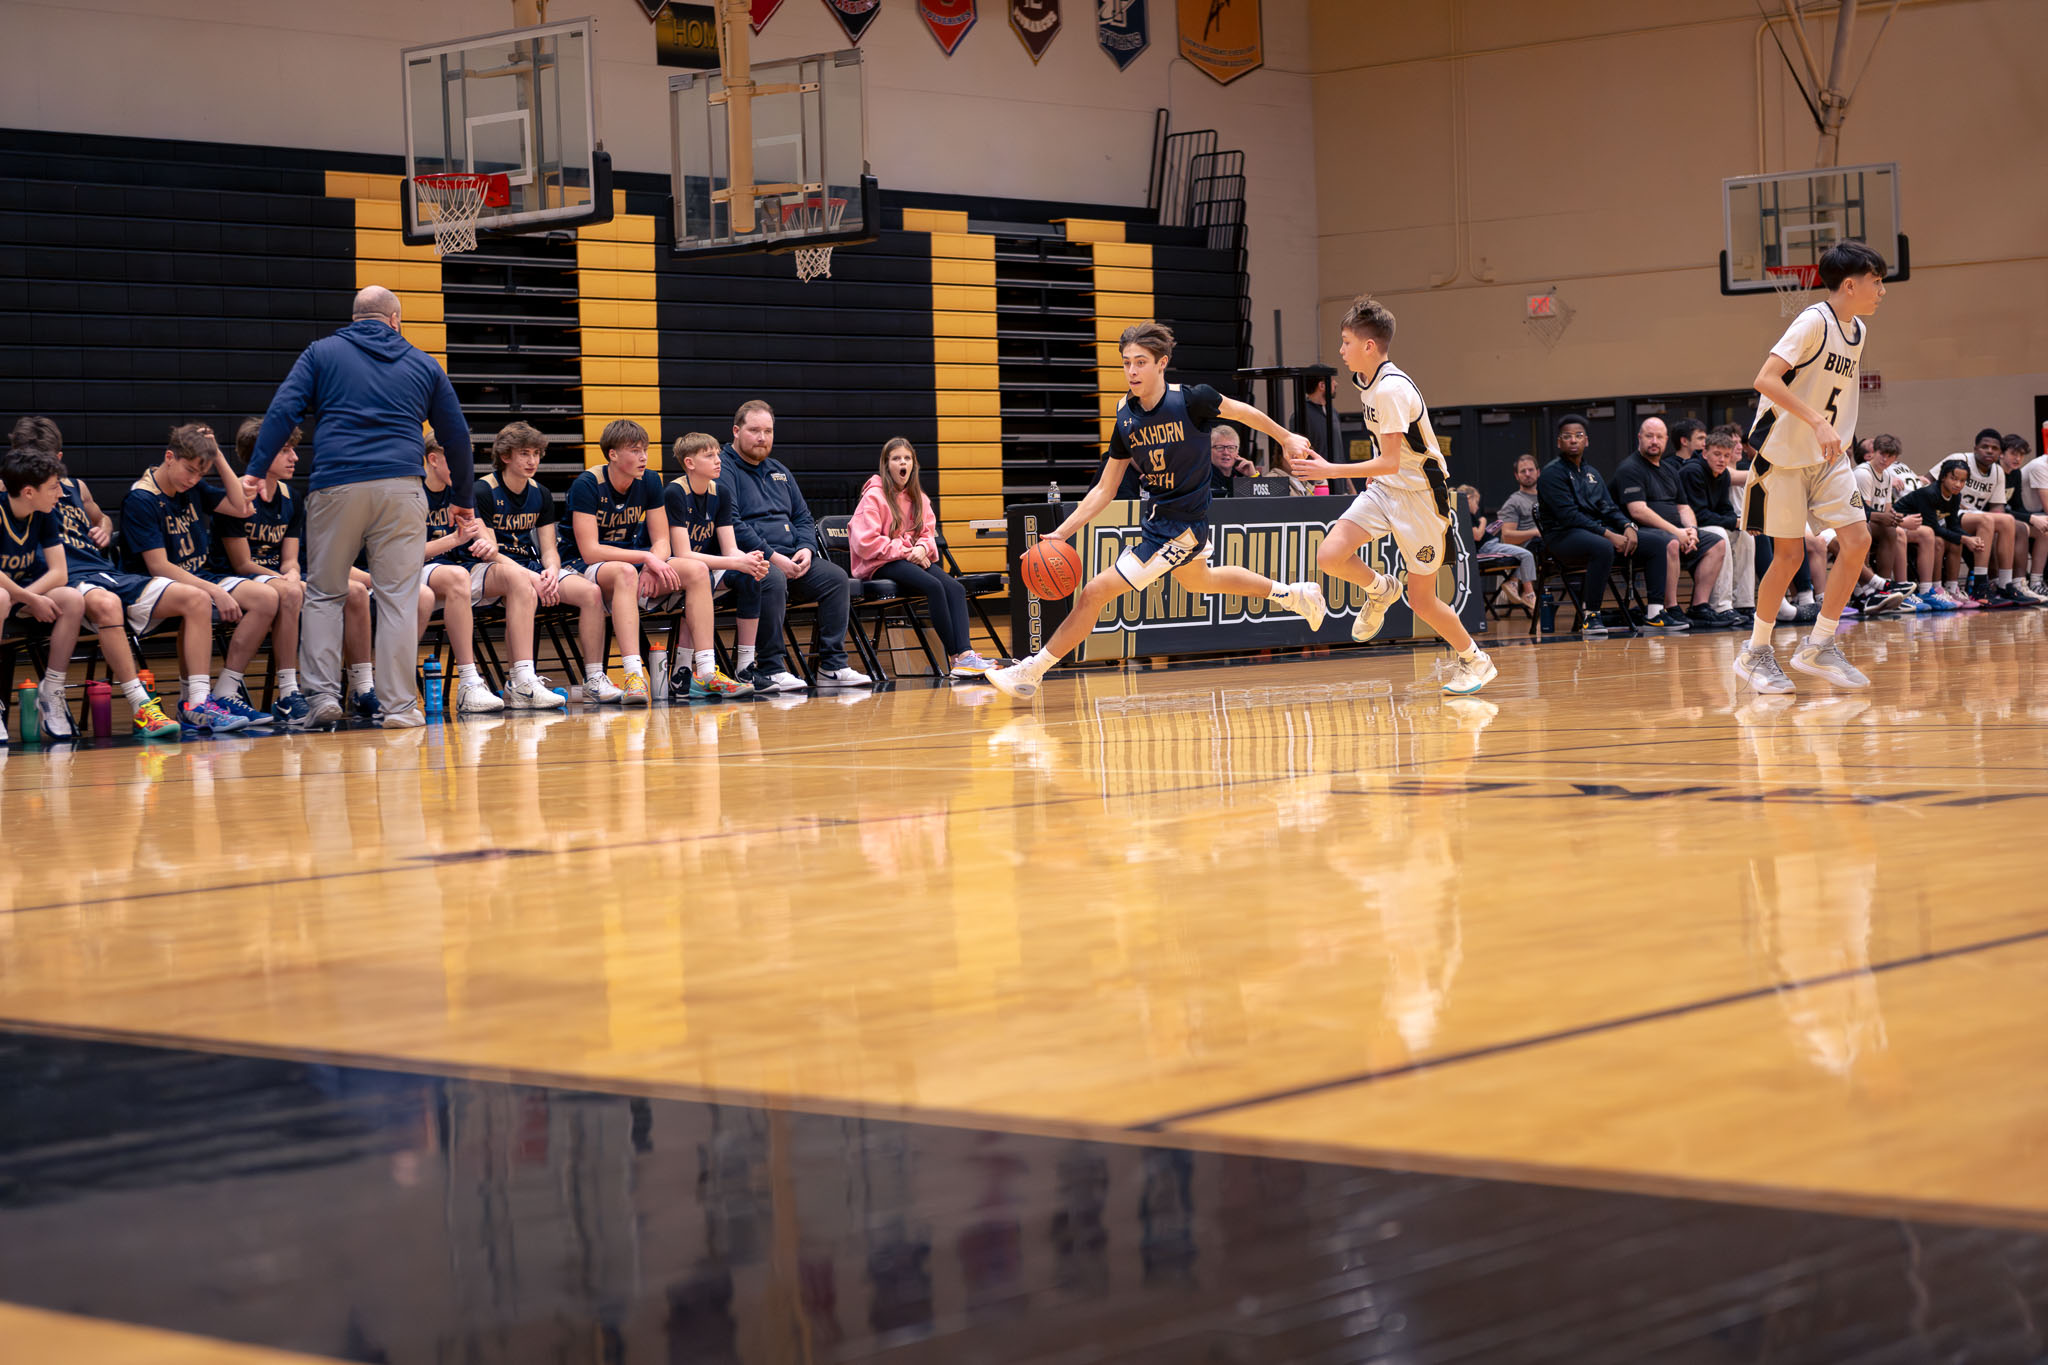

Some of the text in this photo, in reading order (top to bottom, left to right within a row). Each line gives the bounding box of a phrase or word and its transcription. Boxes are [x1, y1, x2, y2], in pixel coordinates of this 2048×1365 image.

[672, 18, 718, 49] HOM
[1824, 352, 1856, 378] BUR
[1825, 386, 1842, 427] 5
[1129, 420, 1185, 449] ELKHORN
[1148, 448, 1166, 472] 10
[1253, 483, 1271, 496] POSS.
[1967, 479, 1994, 493] BURKE
[493, 512, 540, 531] ELKHORN
[596, 506, 642, 528] ELKHORN
[244, 522, 289, 543] ELKHOR
[826, 528, 848, 538] BULL
[1222, 524, 1387, 620] BULLD
[1024, 515, 1042, 654] BUOGS
